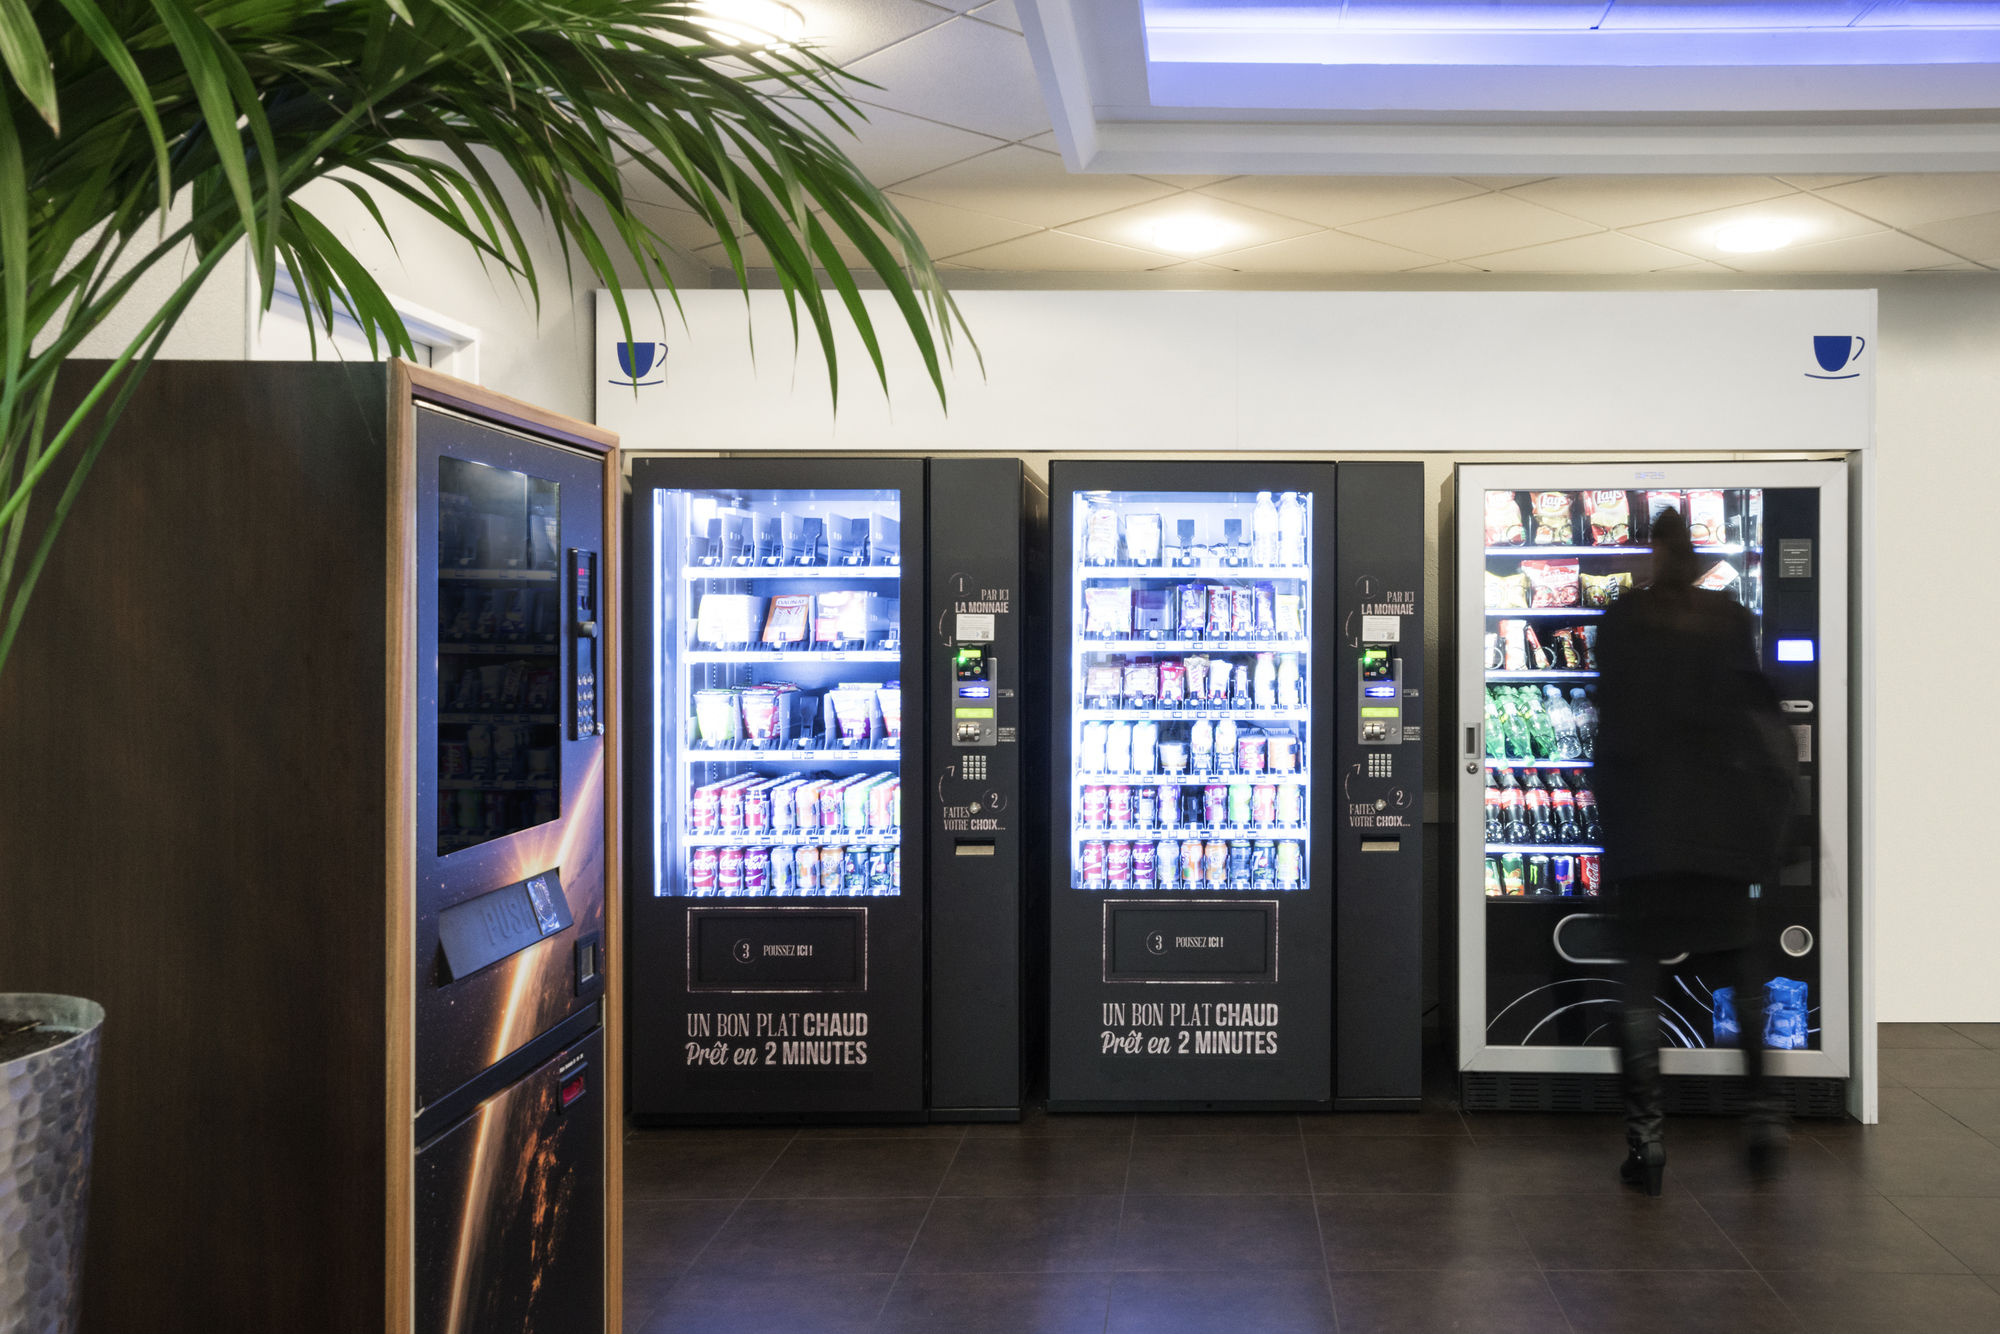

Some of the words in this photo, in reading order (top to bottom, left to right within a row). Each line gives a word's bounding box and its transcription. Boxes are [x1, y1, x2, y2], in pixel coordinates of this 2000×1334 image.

[981, 589, 998, 600] PAR
[1387, 592, 1402, 602] PAR
[955, 602, 966, 613] LA
[968, 602, 1009, 613] MONNAIE
[1361, 604, 1372, 615] LA
[1374, 604, 1414, 615] MONNAIE
[991, 793, 999, 808] 2
[1396, 790, 1404, 805] 2
[943, 807, 970, 818] FAITES
[1349, 804, 1375, 815] FAITES
[943, 820, 968, 830] VOTRE
[1349, 817, 1374, 827] VOTRE
[1155, 935, 1162, 950] 3
[1175, 936, 1207, 948] POUSSEZ
[742, 943, 749, 958] 3
[763, 944, 795, 956] POUSSEZ
[1103, 1003, 1125, 1026] UN
[1131, 1003, 1164, 1026] BON
[1170, 1003, 1212, 1026] PLAT
[1215, 1003, 1279, 1026] CHAUD
[687, 1013, 711, 1037] UN
[717, 1013, 750, 1037] BON
[756, 1013, 800, 1037] PLAT
[803, 1012, 868, 1036] CHAUD
[1100, 1030, 1143, 1054] Prêt
[1147, 1036, 1172, 1054] en
[1178, 1031, 1190, 1054] 2
[1195, 1031, 1278, 1054] MINUTES
[685, 1041, 728, 1066] Prêt
[733, 1046, 758, 1066] en
[764, 1041, 777, 1065] 2
[782, 1041, 868, 1065] MINUTES
